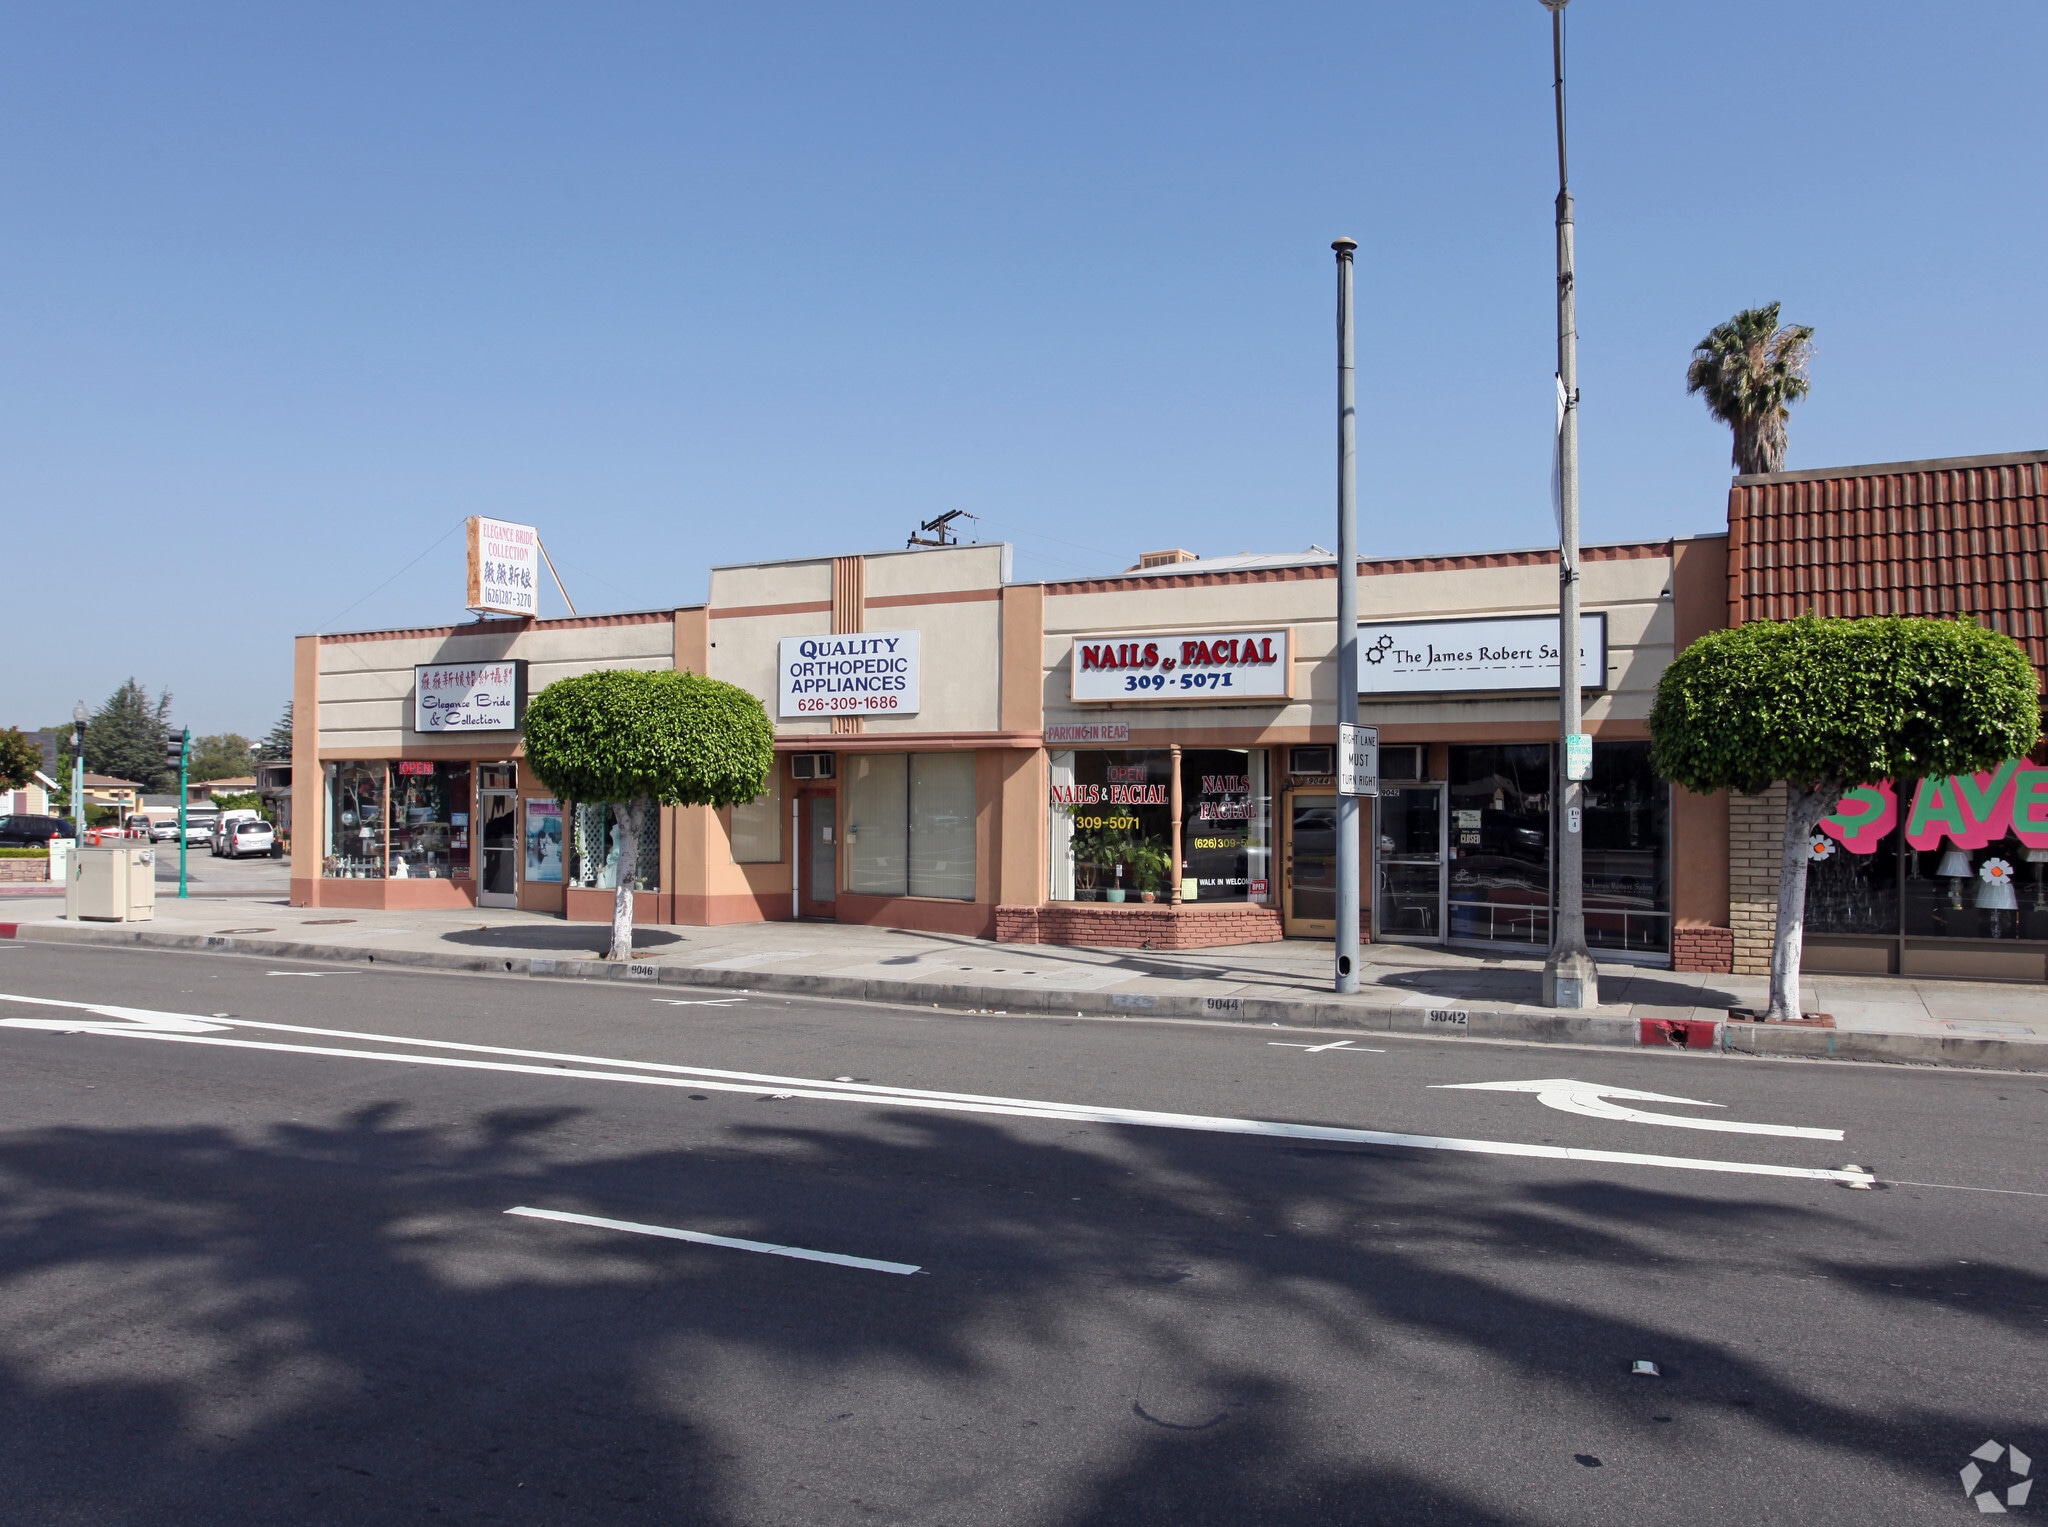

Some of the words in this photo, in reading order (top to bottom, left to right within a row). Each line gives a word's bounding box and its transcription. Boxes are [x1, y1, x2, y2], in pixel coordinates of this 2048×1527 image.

[483, 523, 514, 541] ELEGANCE
[515, 529, 534, 546] BRIDE
[488, 542, 529, 561] COLLECTION
[484, 560, 532, 589] 薇薇新娘
[485, 586, 532, 608] (626)287-3270
[1082, 643, 1159, 669] NAILS
[1162, 657, 1176, 671] &
[1181, 638, 1278, 665] FACIAL
[1392, 650, 1422, 664] The
[1427, 644, 1473, 668] James
[1479, 646, 1532, 662] Robert
[1538, 644, 1585, 660] San
[790, 658, 908, 677] ORTHOPEDIC
[791, 676, 906, 694] APPLIANCES
[422, 695, 470, 712] Elegance
[474, 693, 511, 707] Bride
[798, 695, 898, 711] 626-309-1686
[429, 711, 441, 726] &
[444, 711, 501, 726] Collection
[1048, 727, 1088, 740] PARKING
[1089, 726, 1099, 739] IN
[1101, 725, 1127, 739] REAR
[1342, 733, 1358, 745] RIGHT
[1360, 735, 1376, 747] LANE
[1568, 746, 1592, 755] PARKING
[1348, 753, 1369, 767] MUST
[401, 763, 432, 773] OPEN
[1110, 767, 1144, 780] OPEN
[1202, 775, 1251, 793] NAILS
[1308, 777, 1330, 785] 9044
[1342, 773, 1357, 785] TURN
[1358, 775, 1376, 787] RIGHT
[1051, 784, 1100, 804] NAILS
[1101, 787, 1108, 801] &
[1110, 784, 1168, 804] FACIAL
[1381, 789, 1399, 797] 9042
[1200, 801, 1257, 820] FACIAL
[1076, 817, 1140, 830] 309-5071
[1460, 833, 1481, 844] CLOSED
[1199, 878, 1216, 886] WALK
[1217, 878, 1224, 886] IN
[631, 964, 653, 976] 9046
[1207, 998, 1239, 1011] 9044
[1430, 1009, 1466, 1025] 9042
